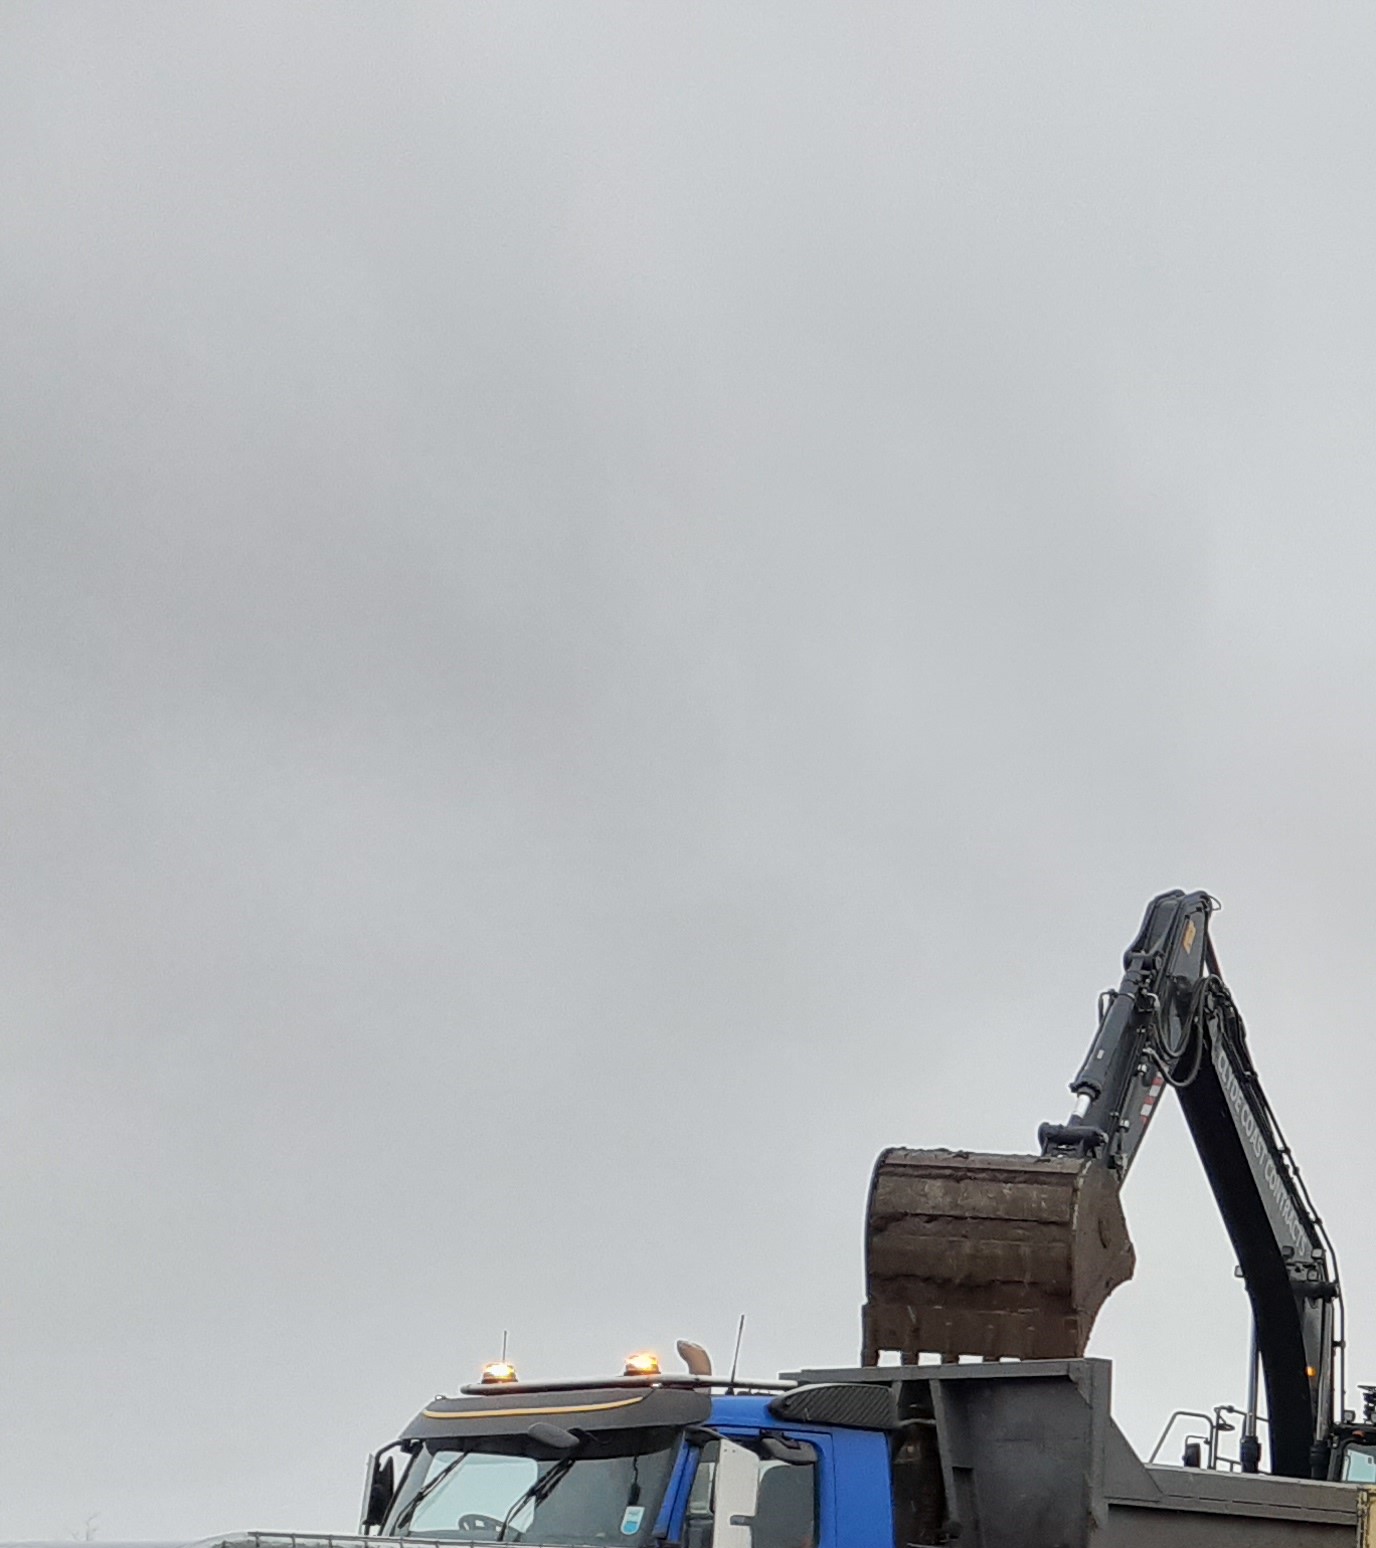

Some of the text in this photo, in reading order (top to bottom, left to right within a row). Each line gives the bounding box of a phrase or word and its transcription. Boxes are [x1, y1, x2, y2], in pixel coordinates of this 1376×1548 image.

[1217, 1052, 1309, 1256] CLYDE COAST CONTRACTS
